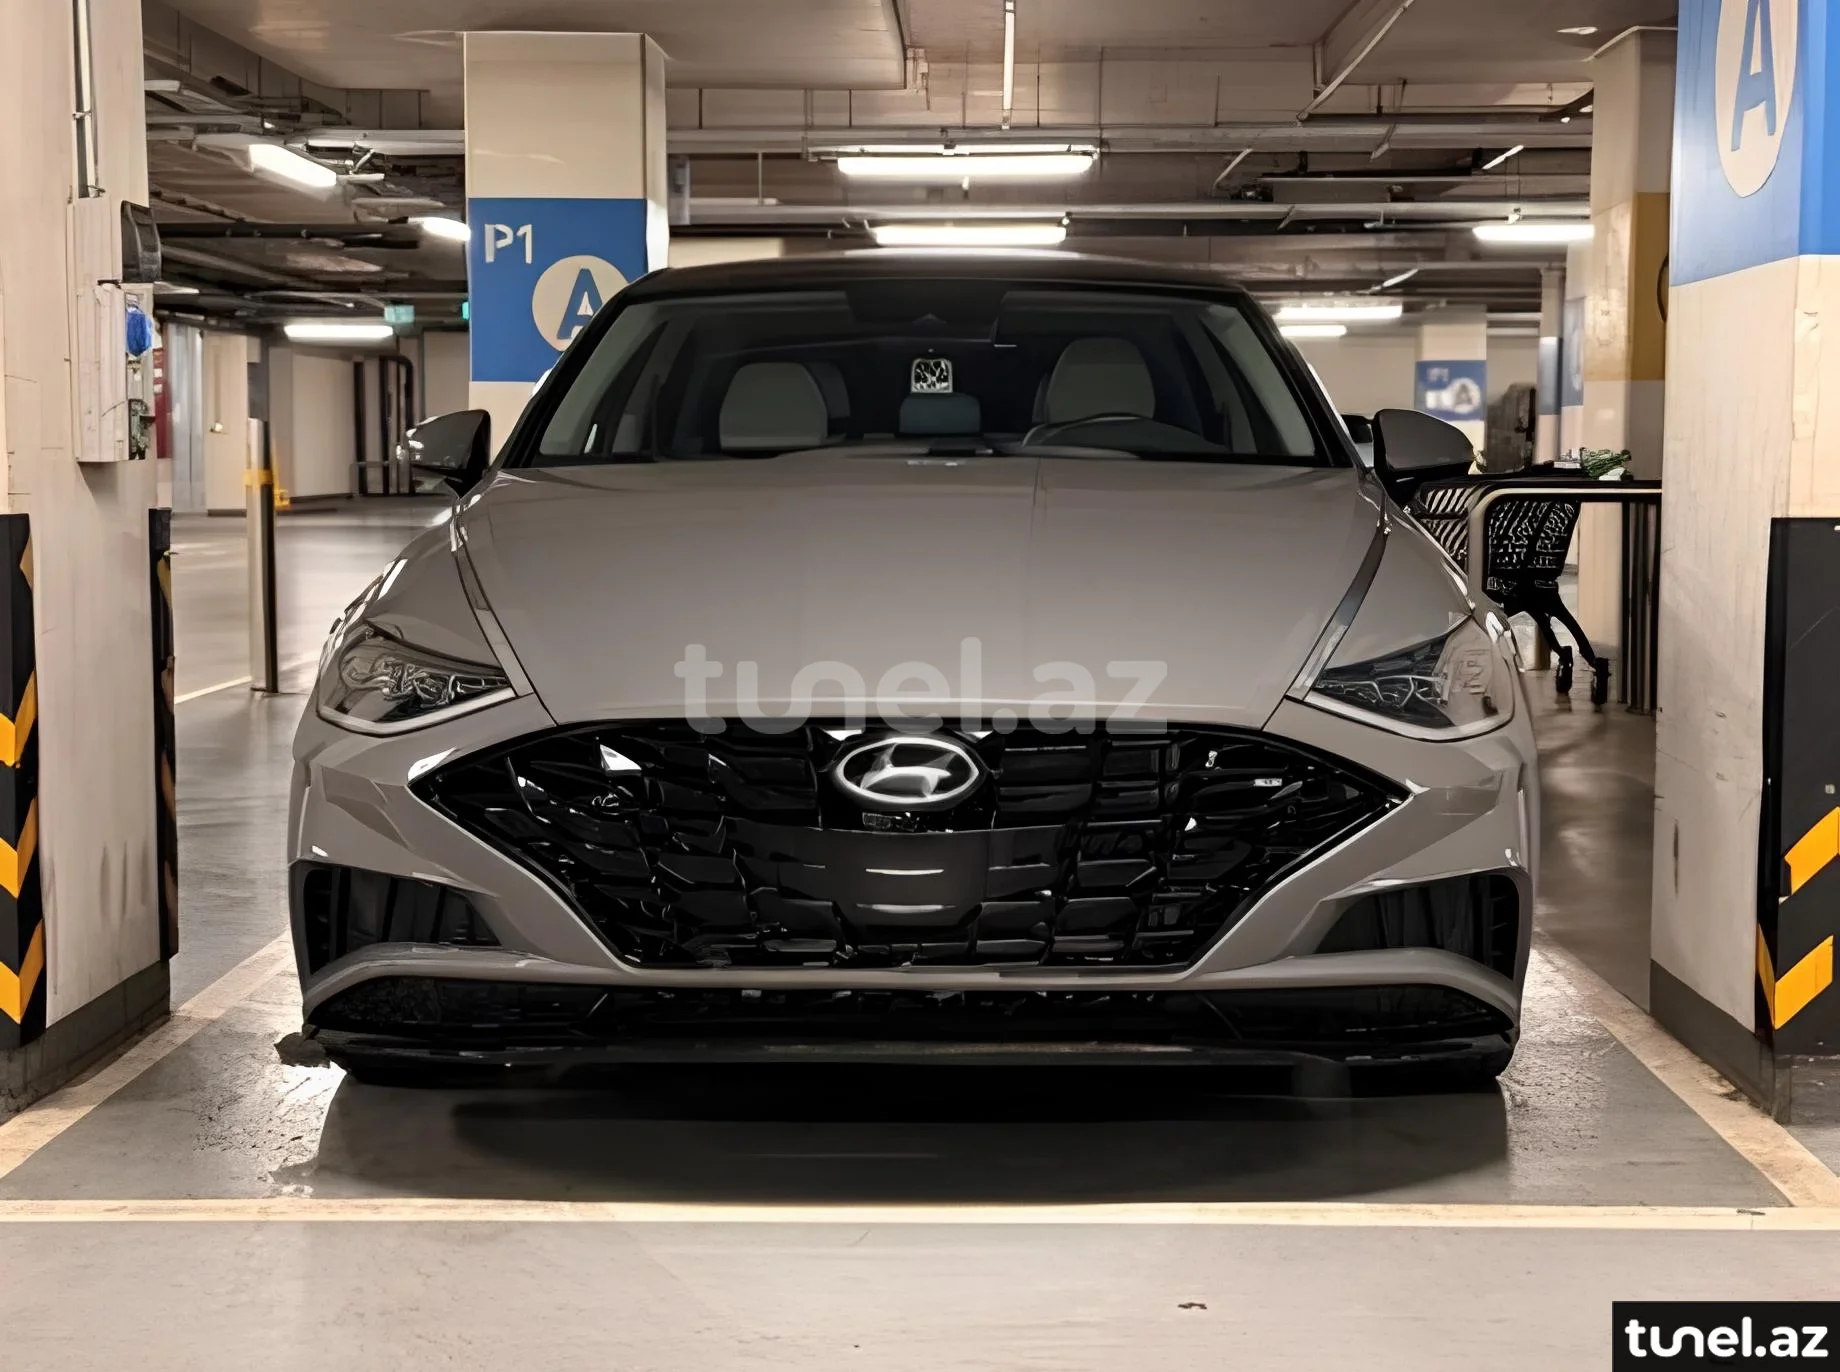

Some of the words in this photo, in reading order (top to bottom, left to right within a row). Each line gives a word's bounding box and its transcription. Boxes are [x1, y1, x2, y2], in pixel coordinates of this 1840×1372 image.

[1731, 0, 1777, 152] A
[484, 223, 533, 264] P1
[556, 267, 604, 340] A
